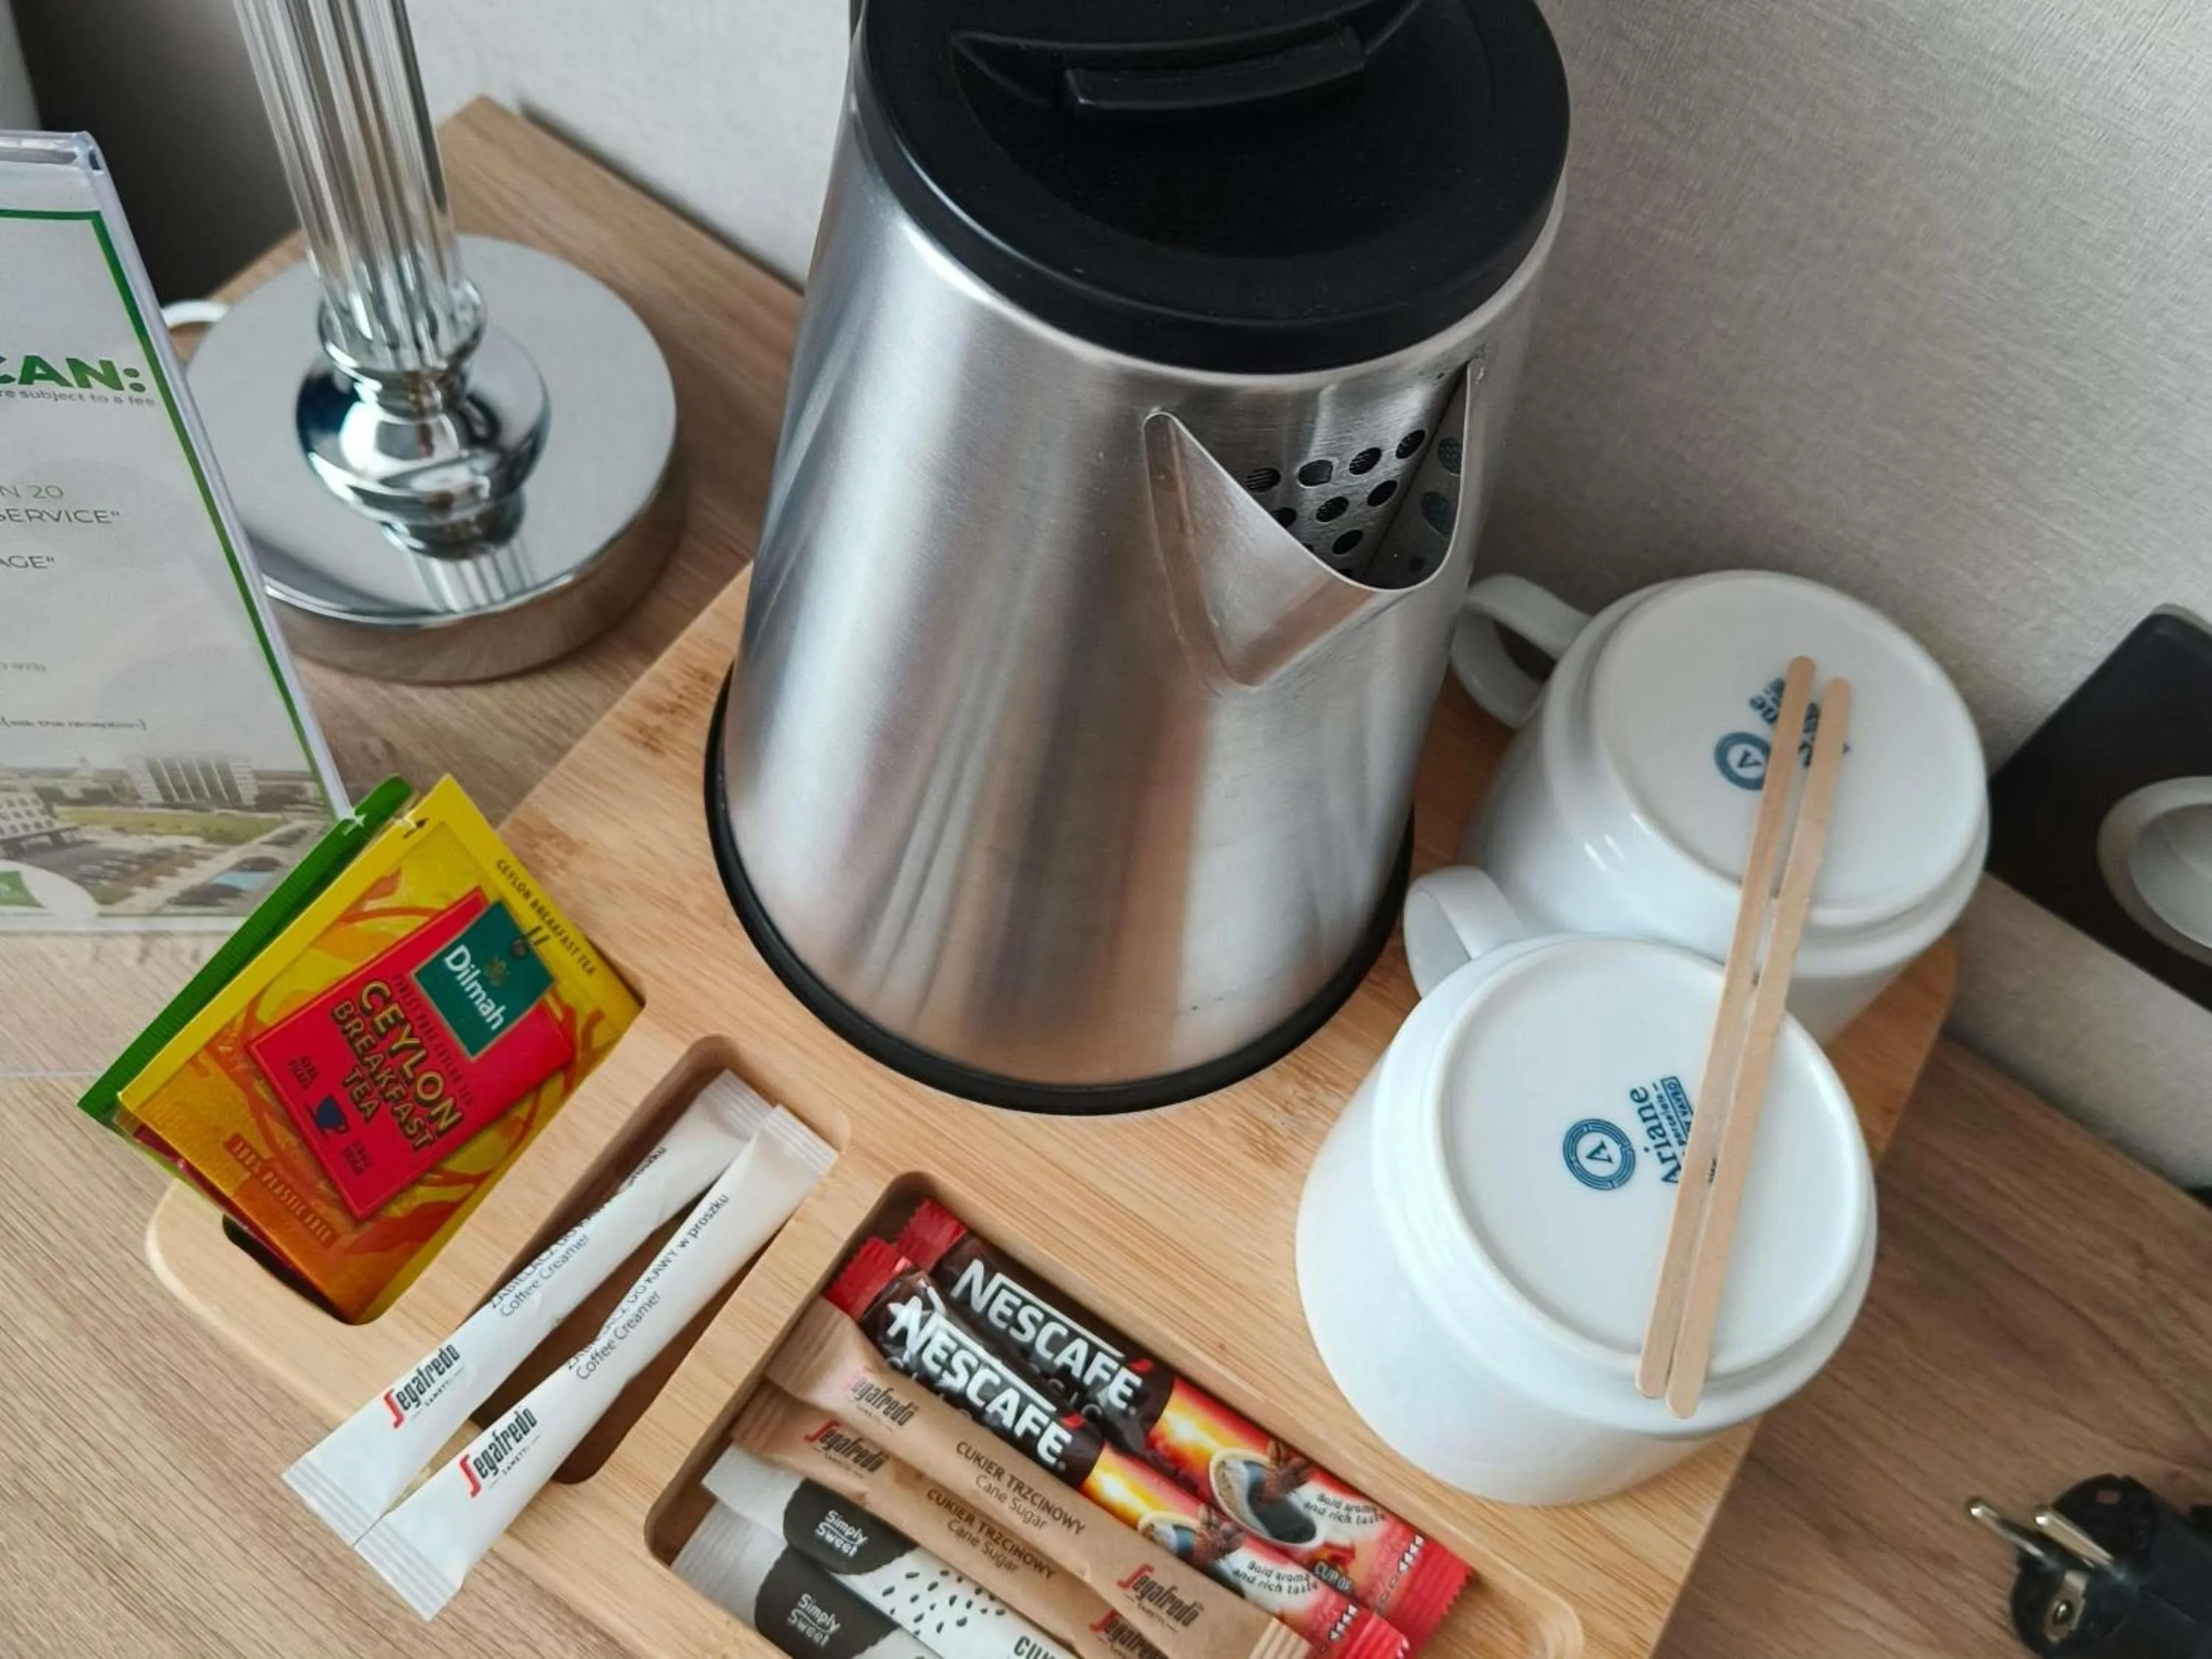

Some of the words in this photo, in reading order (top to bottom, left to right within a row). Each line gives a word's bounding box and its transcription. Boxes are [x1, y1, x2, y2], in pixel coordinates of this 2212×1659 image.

[19, 391, 85, 402] subject
[89, 394, 108, 403] to
[128, 396, 155, 406] fee
[27, 485, 63, 498] 20
[529, 897, 581, 956] BREAKFAST
[444, 945, 506, 1031] Dilmah
[330, 1000, 436, 1151] BREAKFAST
[359, 979, 465, 1136] CEYLON
[342, 1068, 382, 1121] TEA
[1629, 1085, 1682, 1183] Ariane
[687, 1194, 729, 1239] proszku
[500, 1279, 541, 1316] Coffee
[539, 1233, 589, 1279] Creamer
[576, 1340, 616, 1379] Coffee
[613, 1291, 661, 1340] Creamer
[950, 1258, 1152, 1410] NESCAFÉ
[384, 1344, 460, 1428] Segafredo
[887, 1296, 1085, 1465] NESCAFÉ
[459, 1407, 538, 1498] Segafredo
[956, 1441, 1006, 1481] CUKIER
[1006, 1474, 1086, 1535] TRZCINOWY
[975, 1475, 1009, 1503] Cane
[1009, 1497, 1047, 1530] Sugar
[1304, 1501, 1326, 1515] and
[1329, 1512, 1352, 1523] rich
[1317, 1493, 1342, 1509] Bold
[815, 1521, 858, 1557] Sweet
[825, 1509, 869, 1545] Simply
[927, 1488, 976, 1526] CUKIER
[978, 1521, 1057, 1579] TRZCINOWY
[947, 1519, 981, 1547] Cane
[981, 1542, 1021, 1573] Sugar
[1117, 1563, 1202, 1627] Segafredo
[1232, 1569, 1256, 1584] and
[1259, 1581, 1282, 1593] rich
[1248, 1559, 1273, 1577] Bold
[787, 1608, 830, 1647] Sweet
[797, 1593, 841, 1633] Simply
